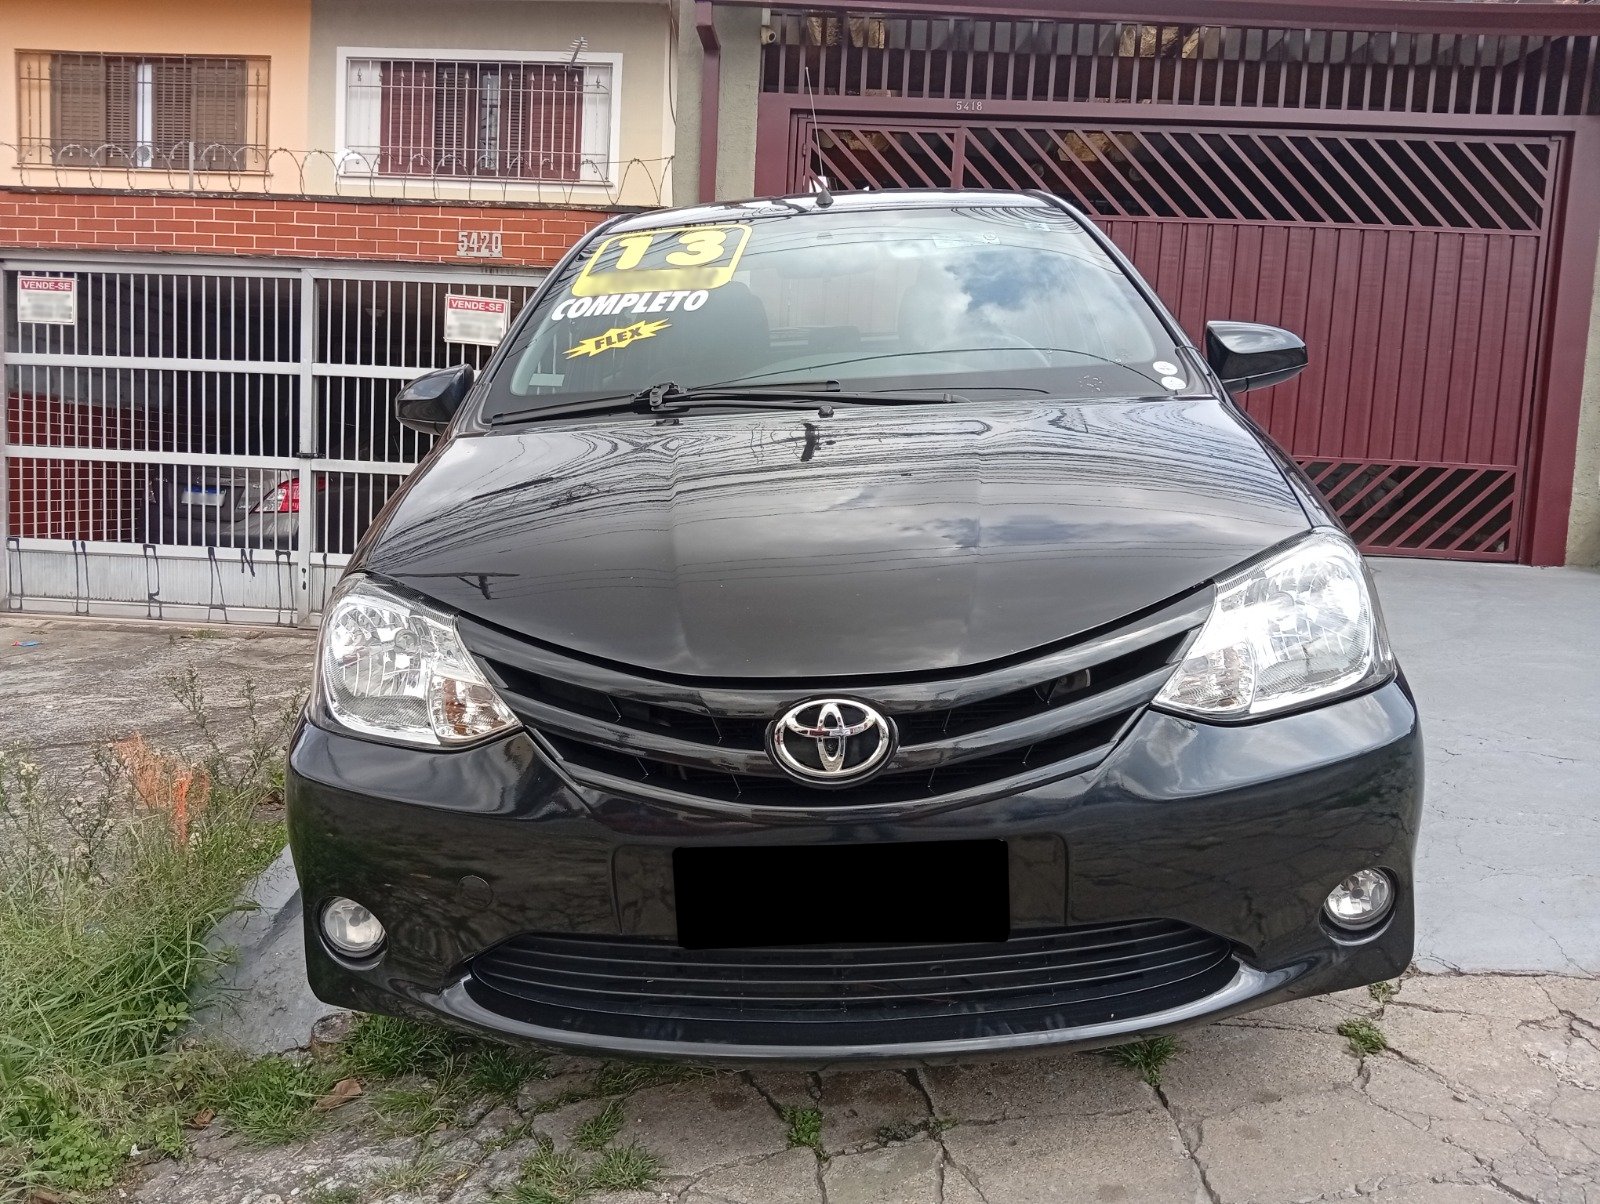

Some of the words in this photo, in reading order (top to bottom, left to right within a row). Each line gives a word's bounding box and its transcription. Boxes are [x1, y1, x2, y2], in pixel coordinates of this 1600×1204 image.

[956, 101, 983, 111] 5418
[457, 231, 502, 257] 5420
[616, 230, 727, 269] 13
[22, 280, 71, 290] VENDE-SE
[450, 299, 503, 312] VENDE-SE
[551, 290, 710, 321] COMPLETO
[594, 326, 643, 350] FLEX
